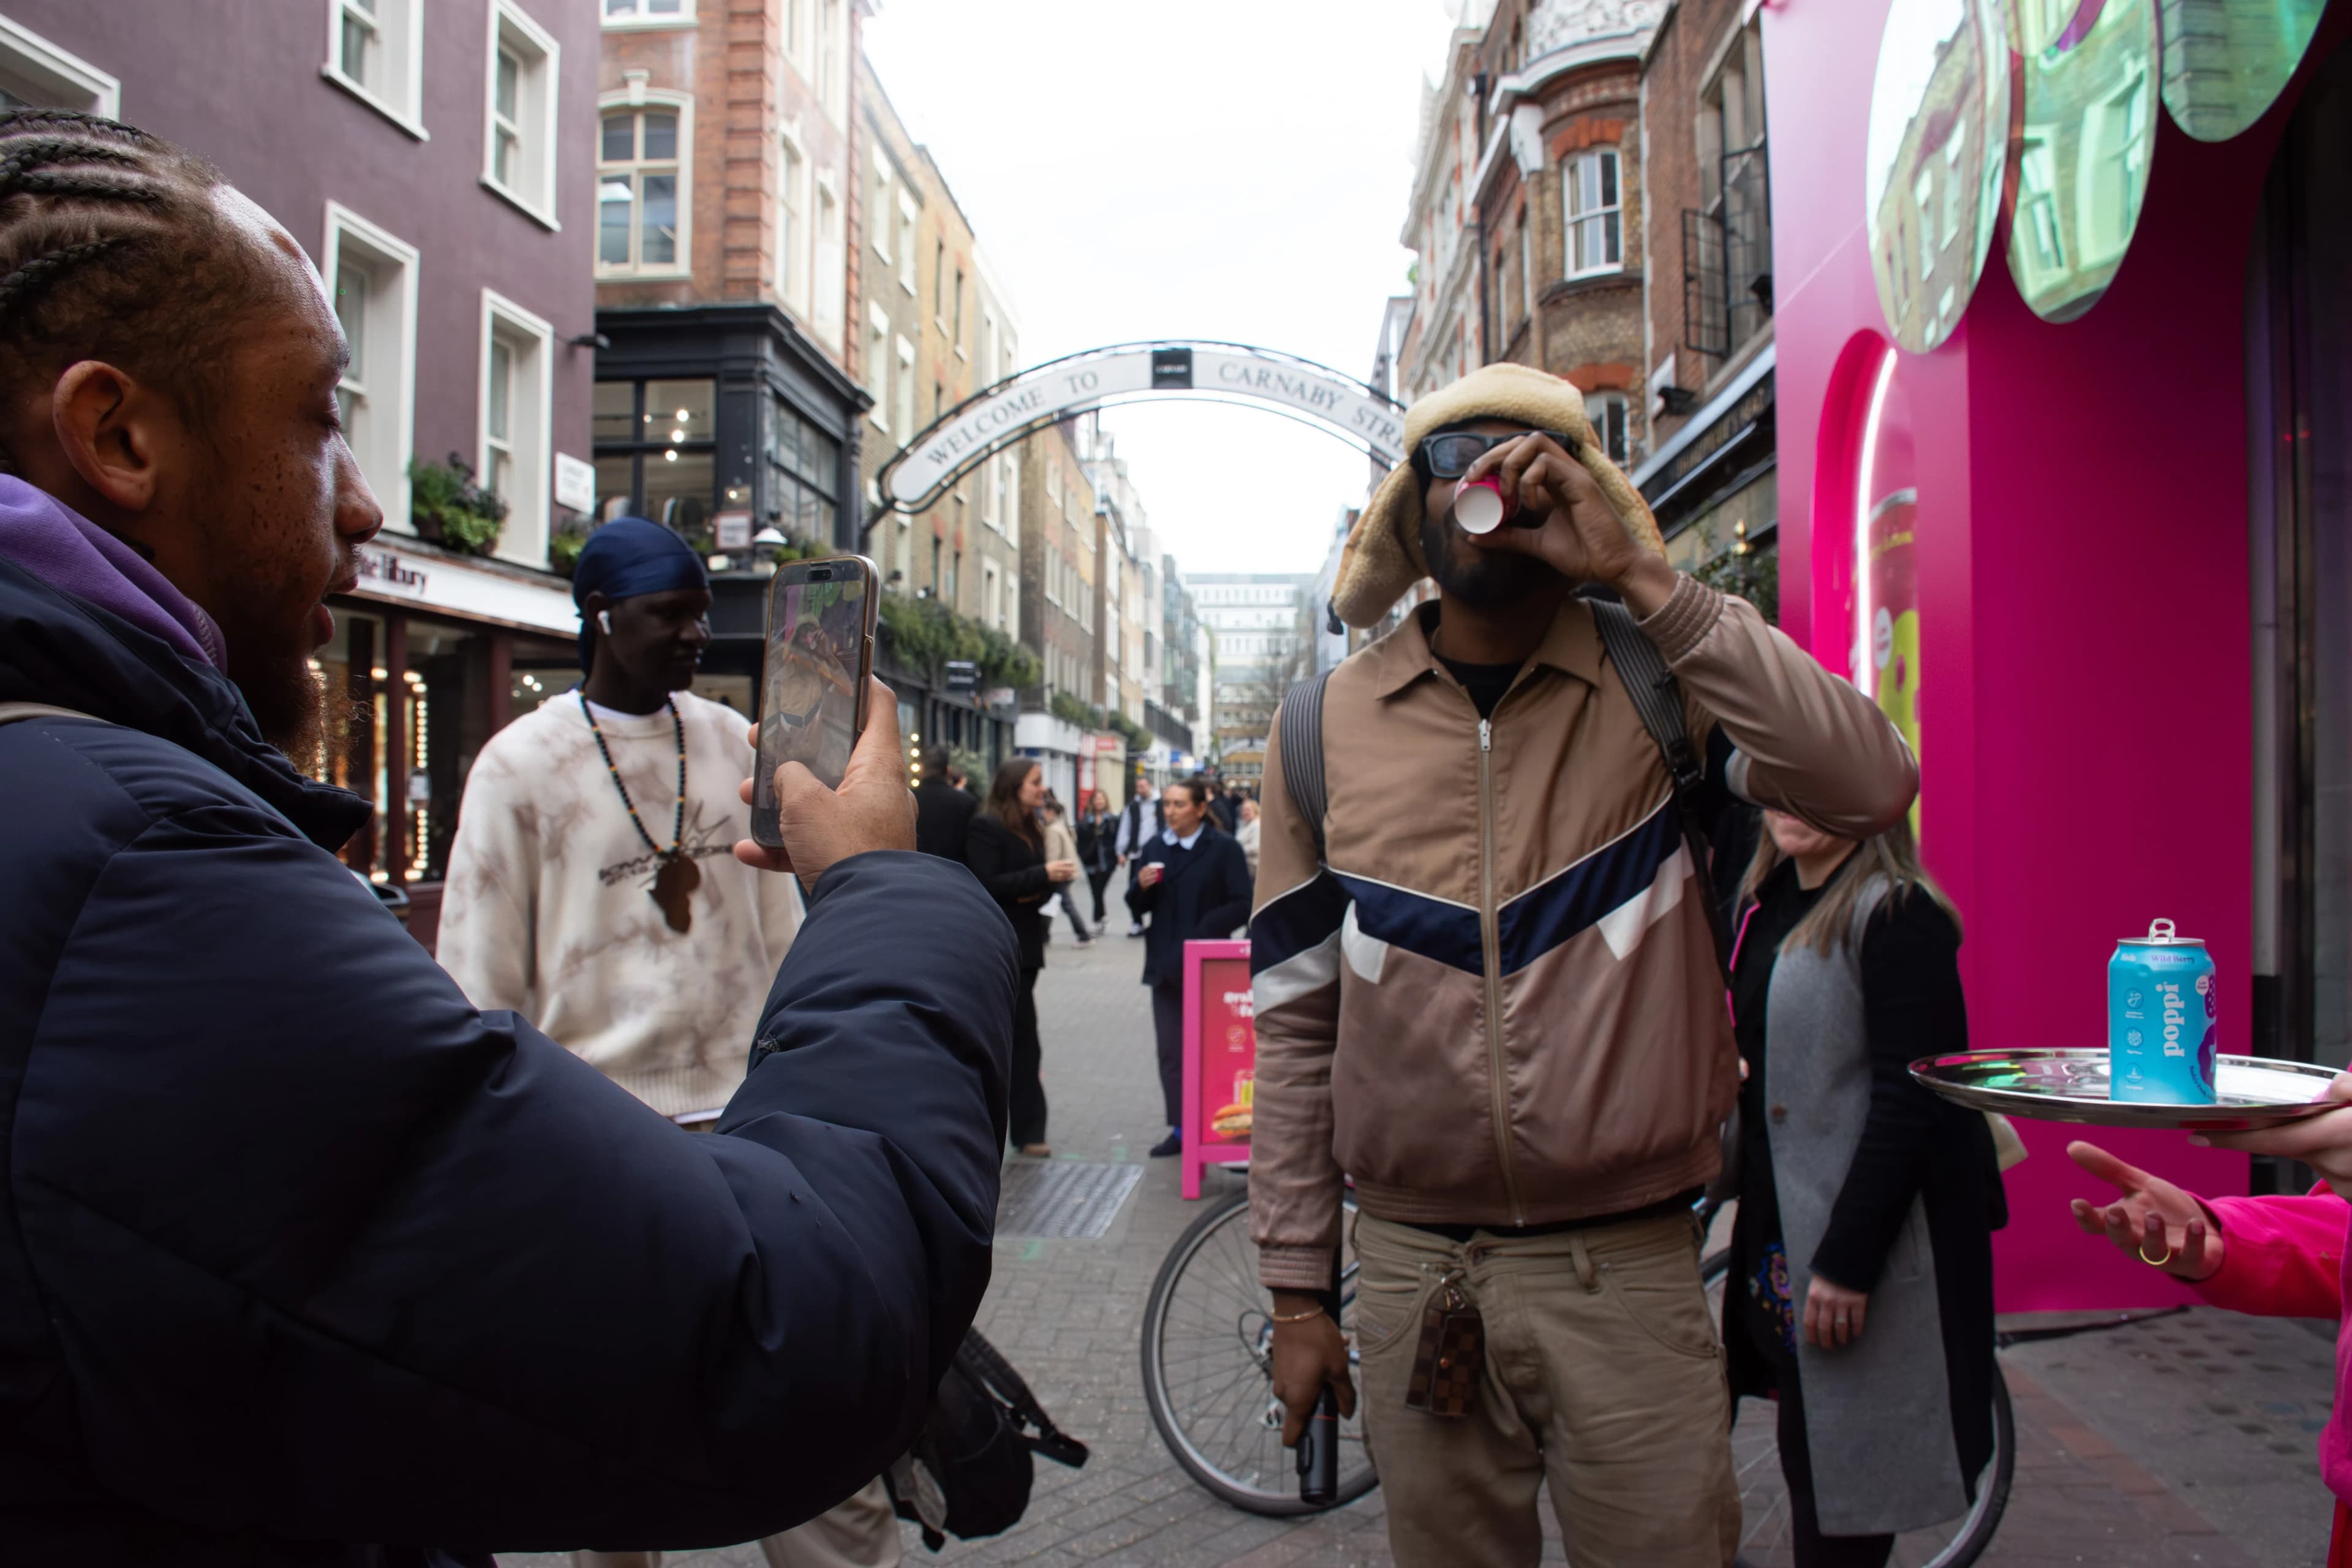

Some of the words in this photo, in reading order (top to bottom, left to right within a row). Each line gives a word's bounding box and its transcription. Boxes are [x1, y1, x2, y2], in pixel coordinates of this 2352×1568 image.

[927, 388, 1046, 466] WELCOME
[1063, 370, 1098, 394] TO
[1218, 362, 1345, 410] CARNABY
[2174, 956, 2195, 964] Berry
[2155, 983, 2185, 1057] poppi
